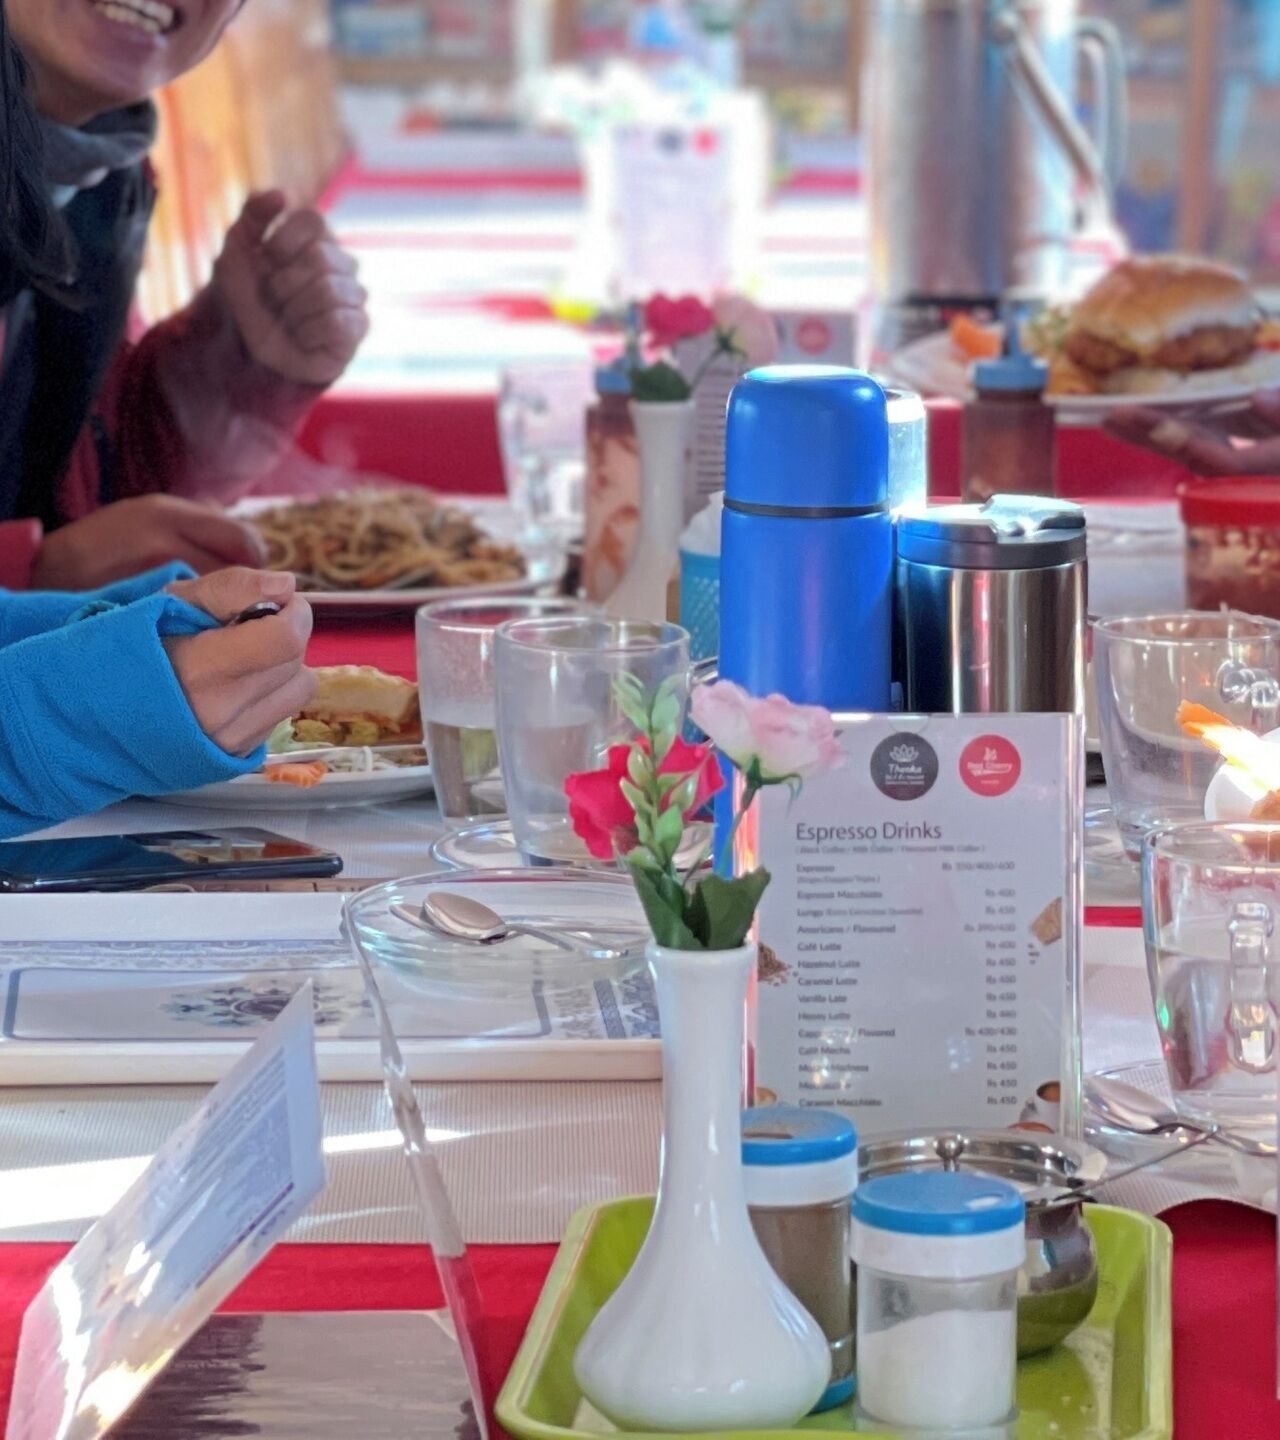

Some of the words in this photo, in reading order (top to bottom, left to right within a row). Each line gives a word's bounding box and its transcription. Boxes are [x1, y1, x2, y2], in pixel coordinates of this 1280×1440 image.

[796, 823, 877, 844] Espresso
[883, 821, 942, 840] Drinks
[797, 925, 844, 933] Americano
[798, 978, 834, 986] Caramel
